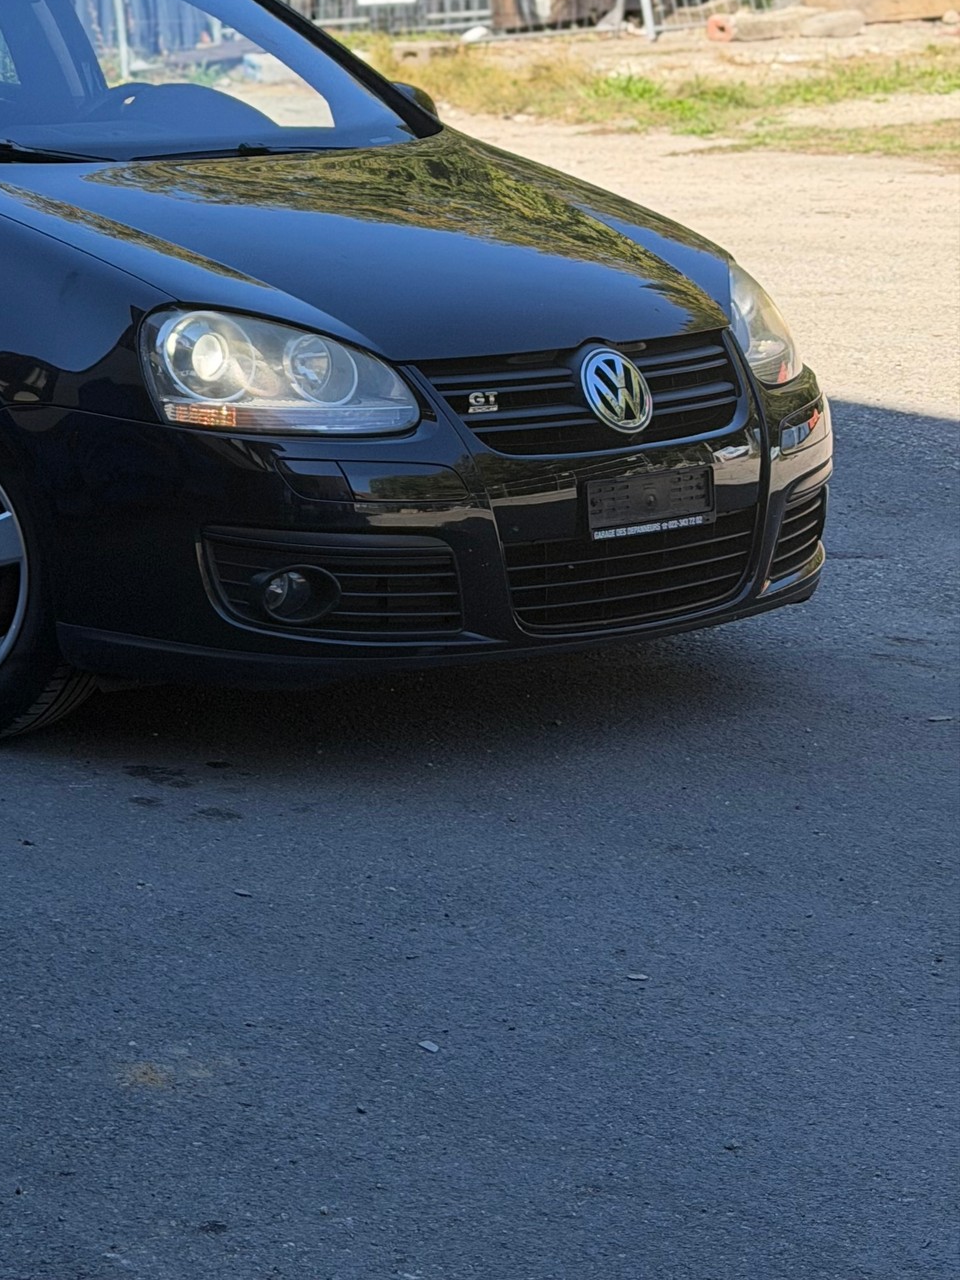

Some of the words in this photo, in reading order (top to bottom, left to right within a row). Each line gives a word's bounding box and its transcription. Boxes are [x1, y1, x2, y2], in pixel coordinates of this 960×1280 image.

[469, 391, 499, 406] GT
[594, 530, 615, 539] GARAGE
[616, 527, 627, 537] DES
